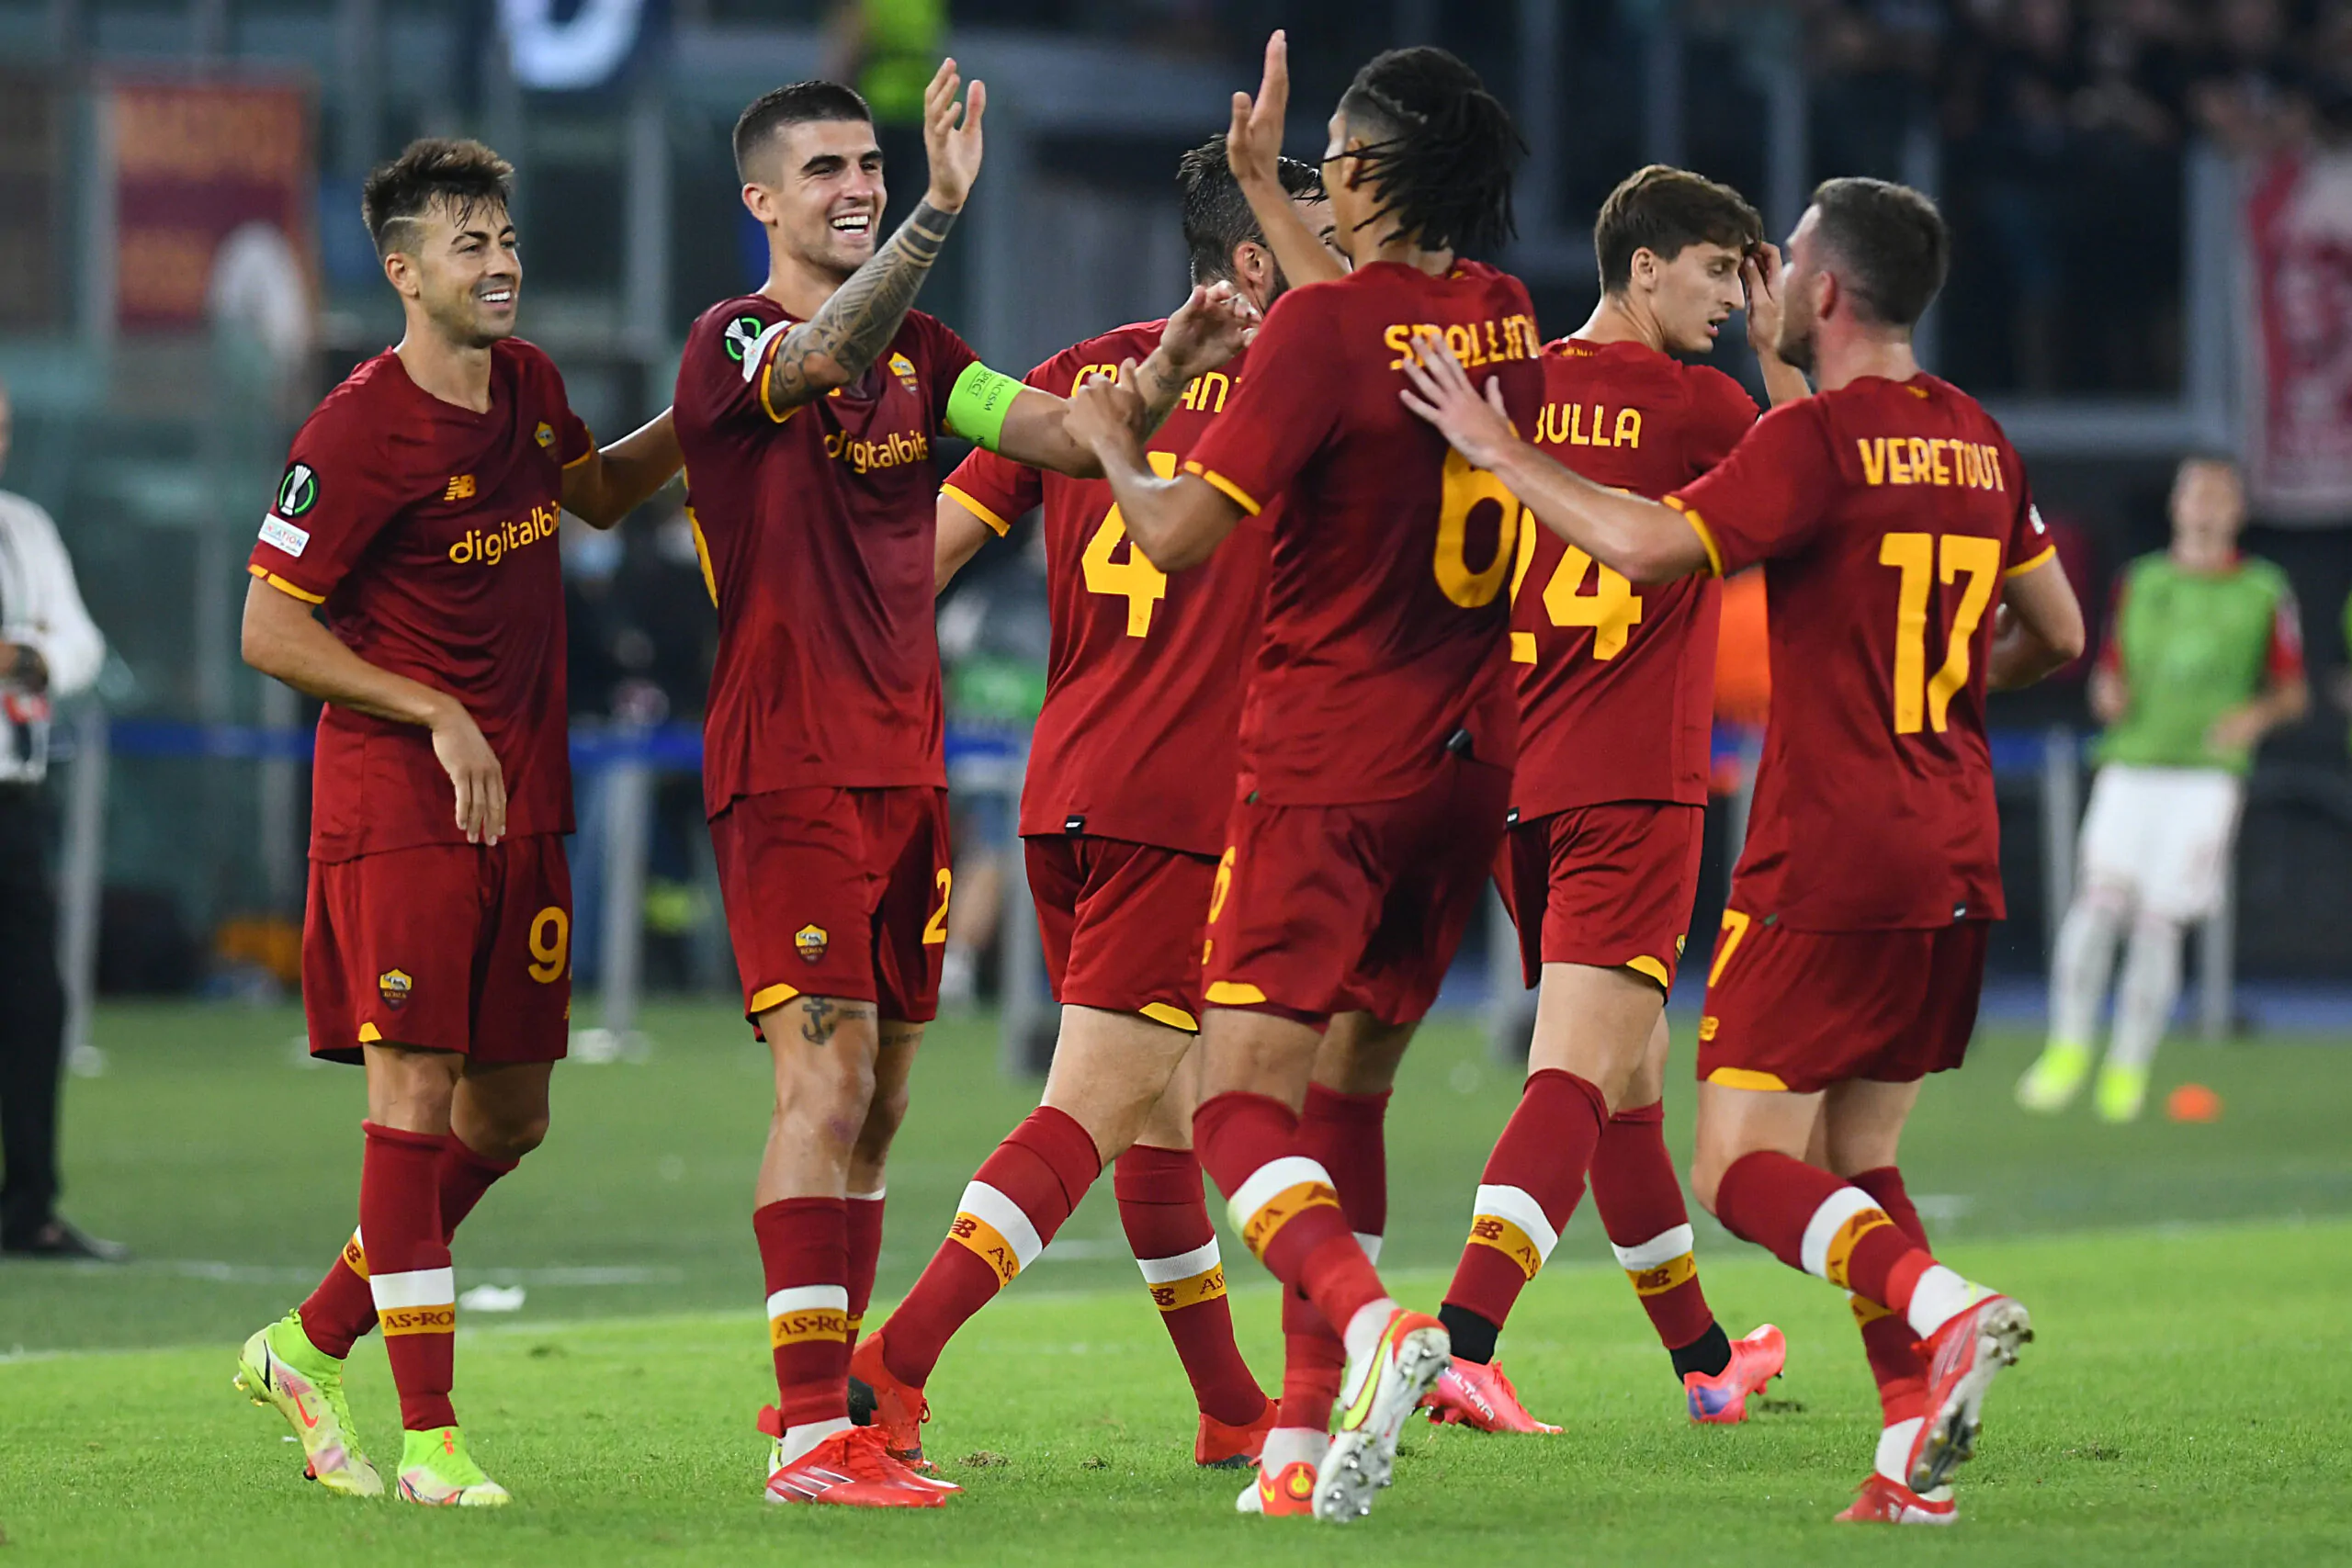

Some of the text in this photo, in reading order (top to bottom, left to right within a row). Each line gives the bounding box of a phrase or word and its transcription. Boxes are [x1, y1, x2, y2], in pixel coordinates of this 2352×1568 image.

[1857, 437, 2004, 491] VERETOUT
[1081, 451, 1177, 637] 4
[1879, 533, 2001, 734] 17
[528, 906, 569, 984] 9
[922, 868, 952, 944] 2
[1707, 908, 1750, 988] 7
